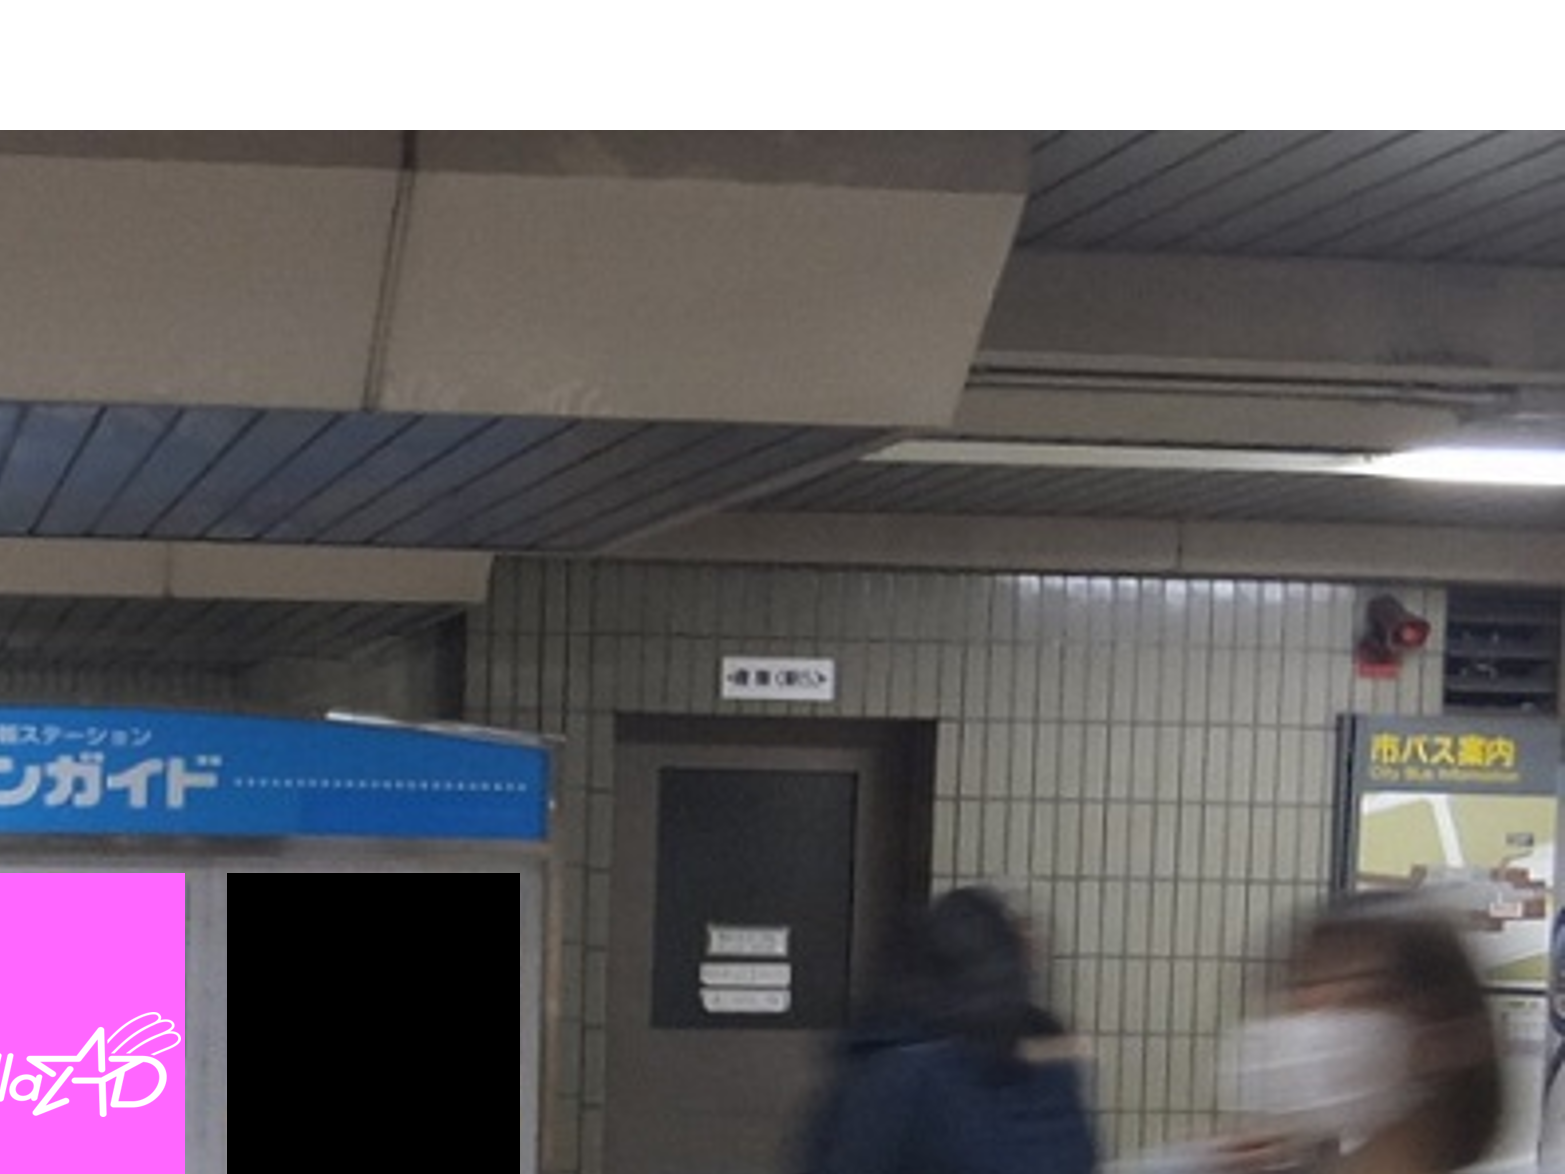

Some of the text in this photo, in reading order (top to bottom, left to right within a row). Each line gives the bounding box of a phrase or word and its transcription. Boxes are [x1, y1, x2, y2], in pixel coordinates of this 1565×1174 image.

[1371, 733, 1515, 767] 市バス案内
